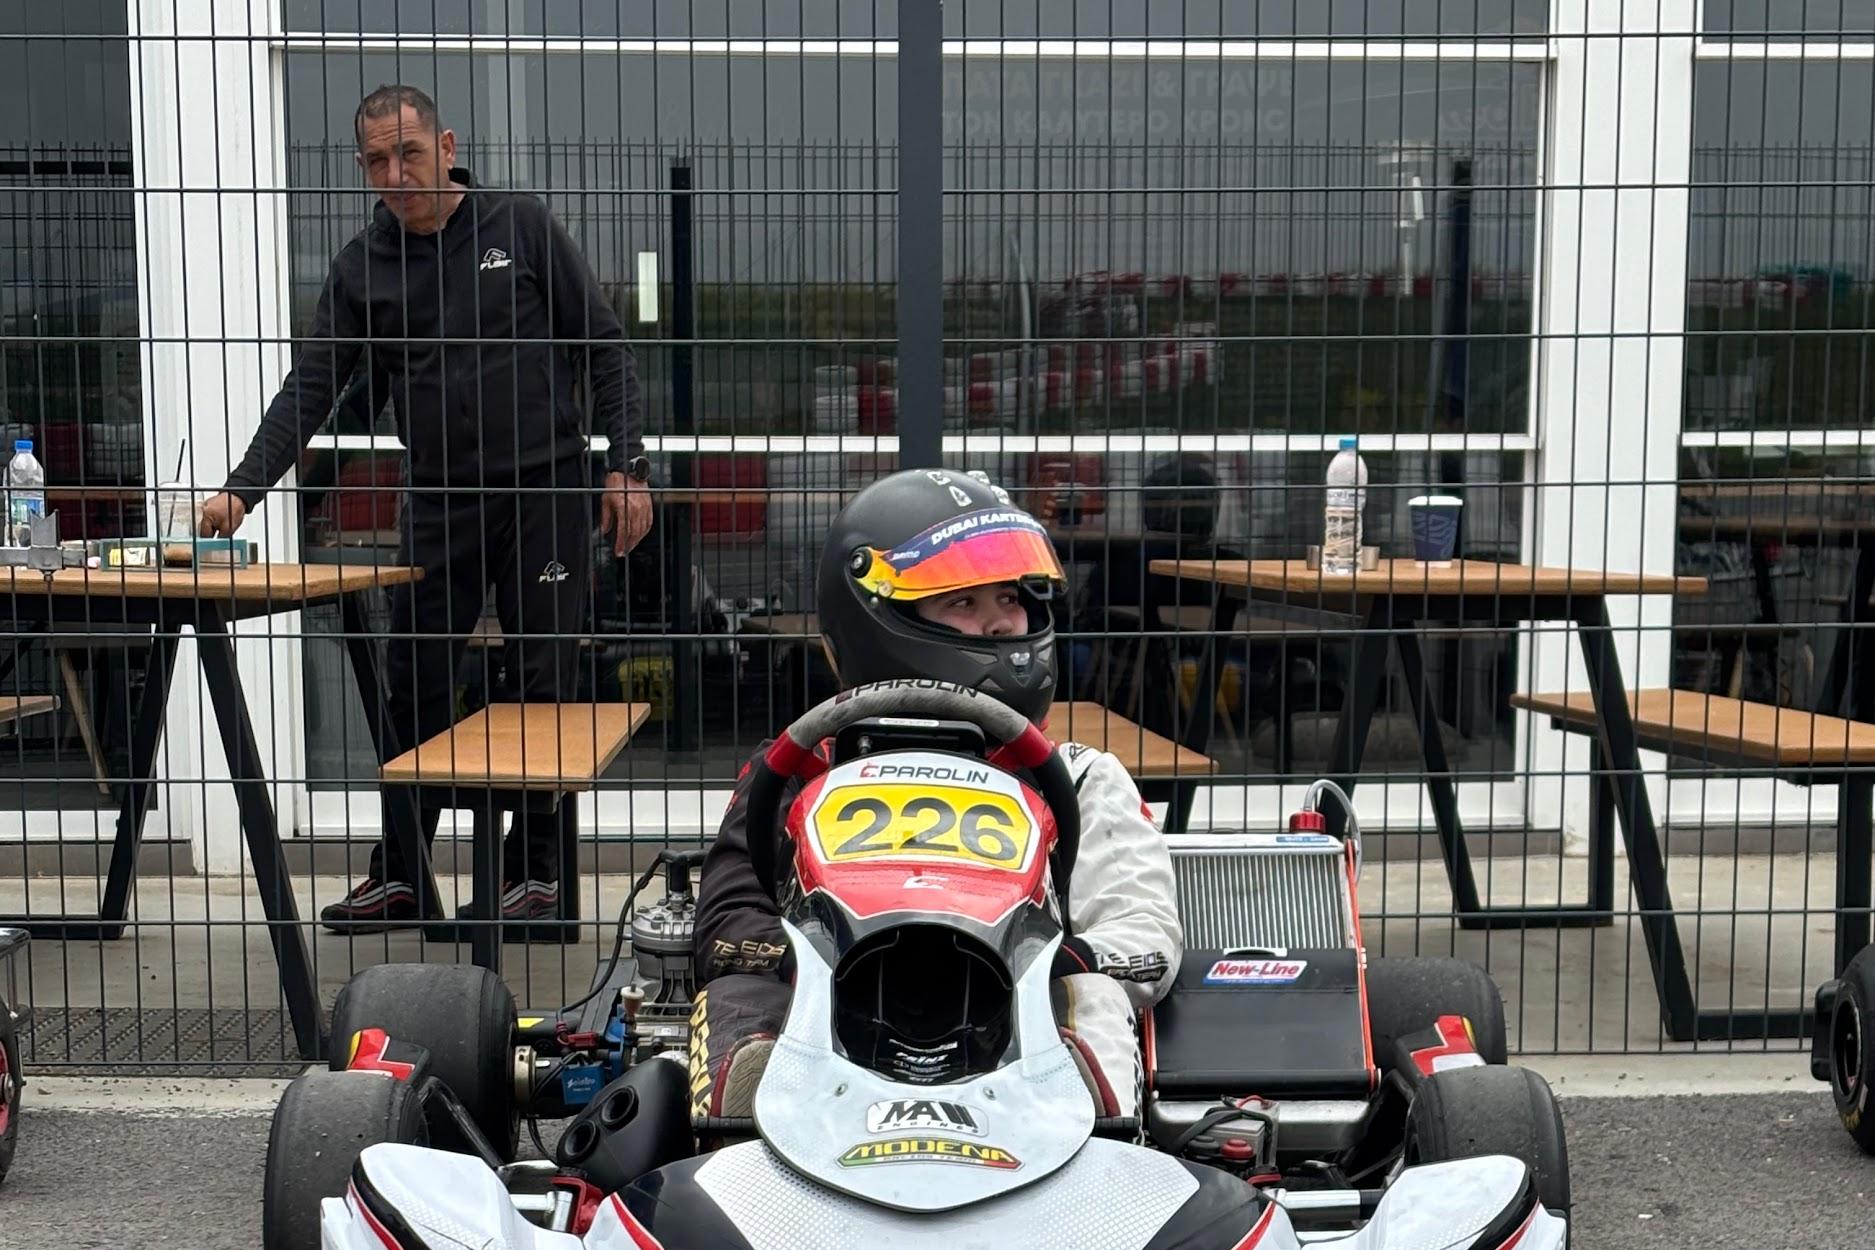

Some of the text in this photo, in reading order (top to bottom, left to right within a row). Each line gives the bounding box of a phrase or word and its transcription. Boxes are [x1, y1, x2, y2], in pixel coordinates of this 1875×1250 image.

[878, 764, 990, 784] PAROLIN
[834, 797, 1018, 862] 226
[1211, 960, 1300, 977] New-Line
[844, 1140, 1015, 1163] MODENA
